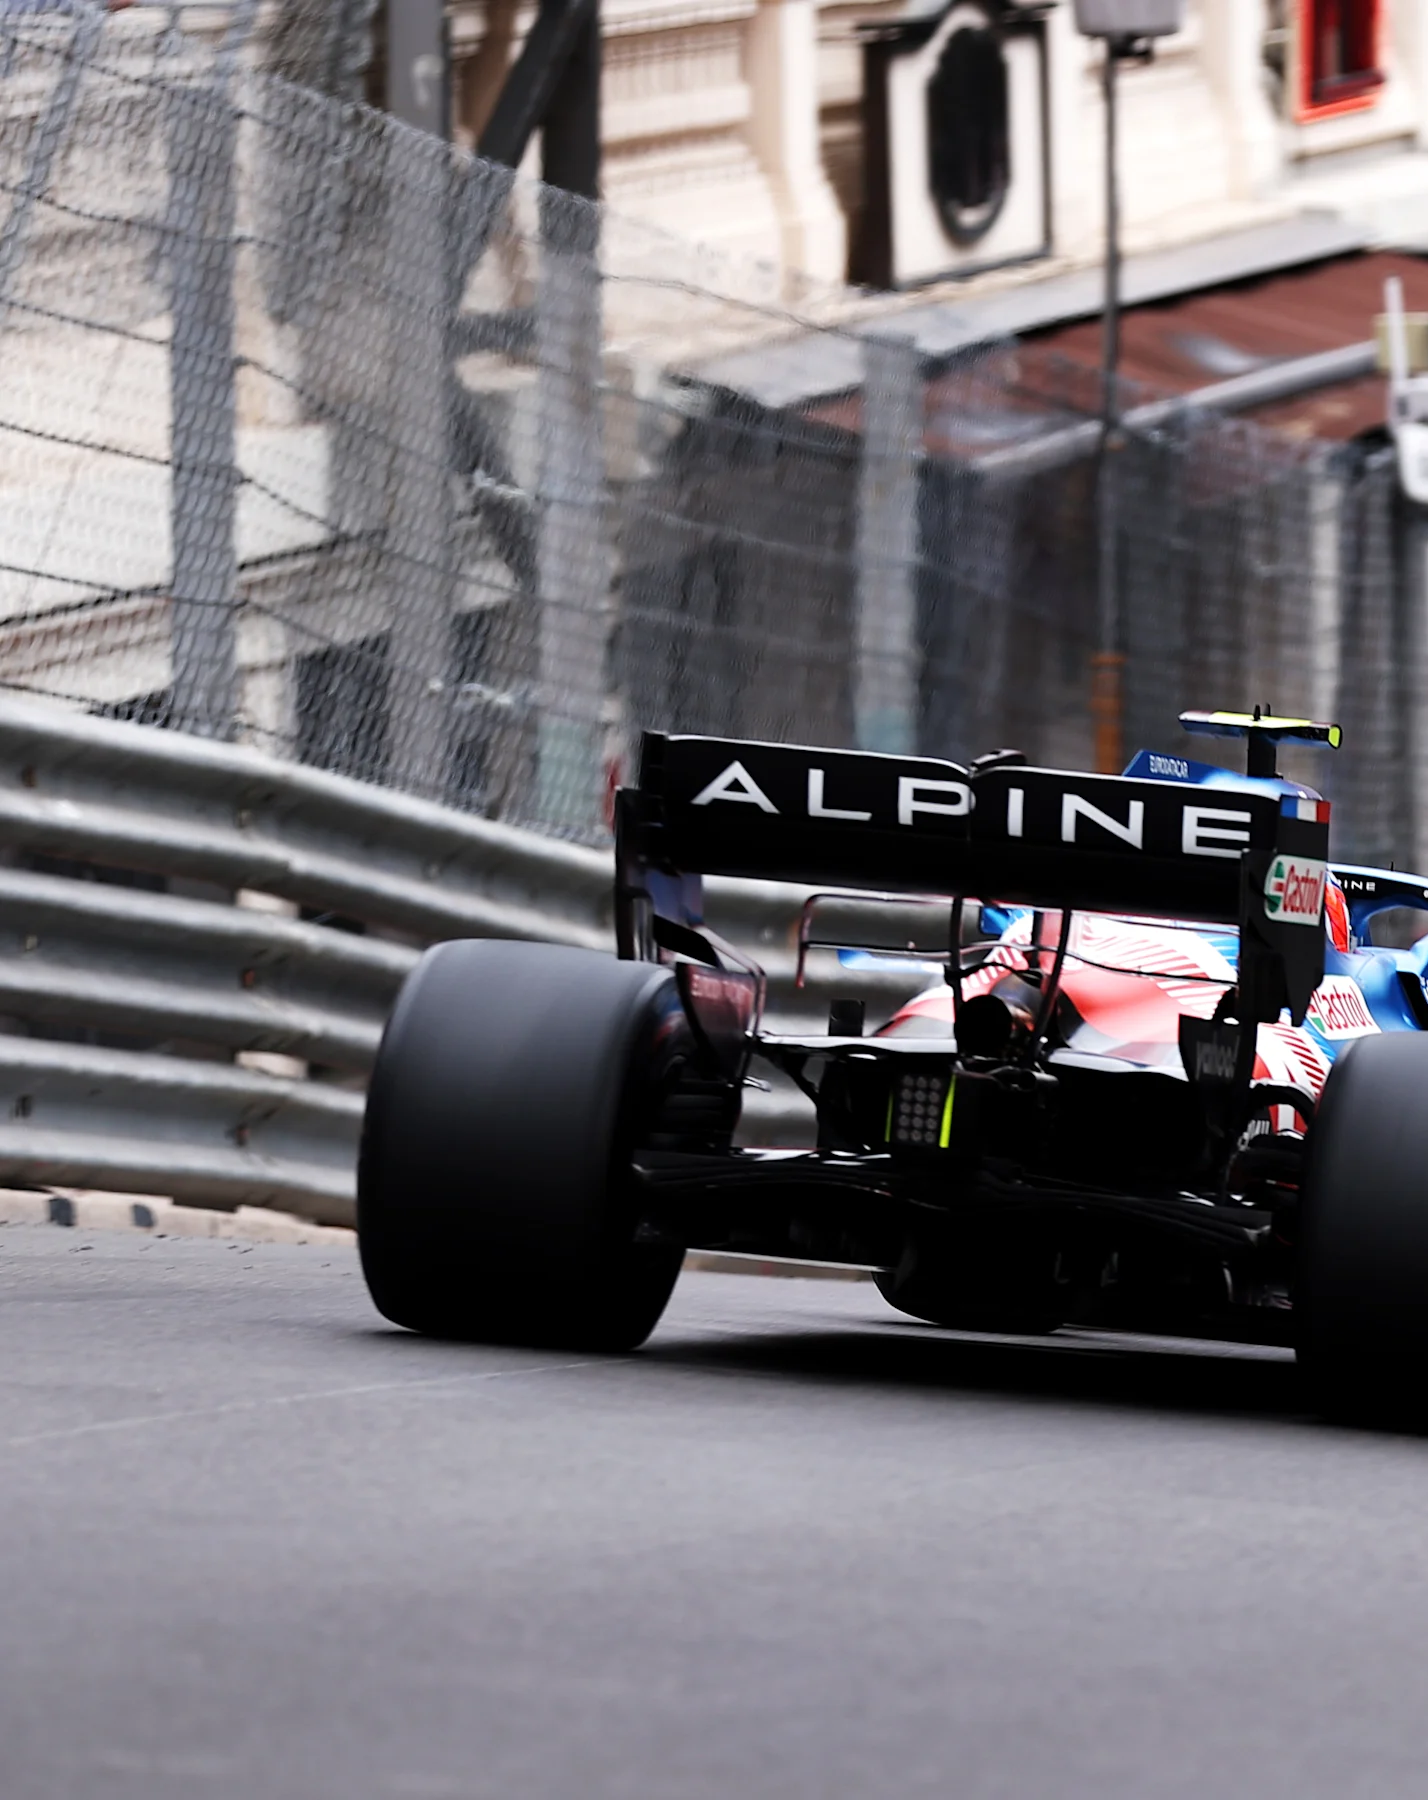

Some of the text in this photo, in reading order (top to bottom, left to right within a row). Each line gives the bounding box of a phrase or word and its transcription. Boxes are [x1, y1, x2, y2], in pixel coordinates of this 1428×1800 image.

[692, 760, 1251, 858] ALPINE
[1283, 864, 1324, 917] Castrol
[1312, 984, 1374, 1031] Castrol
